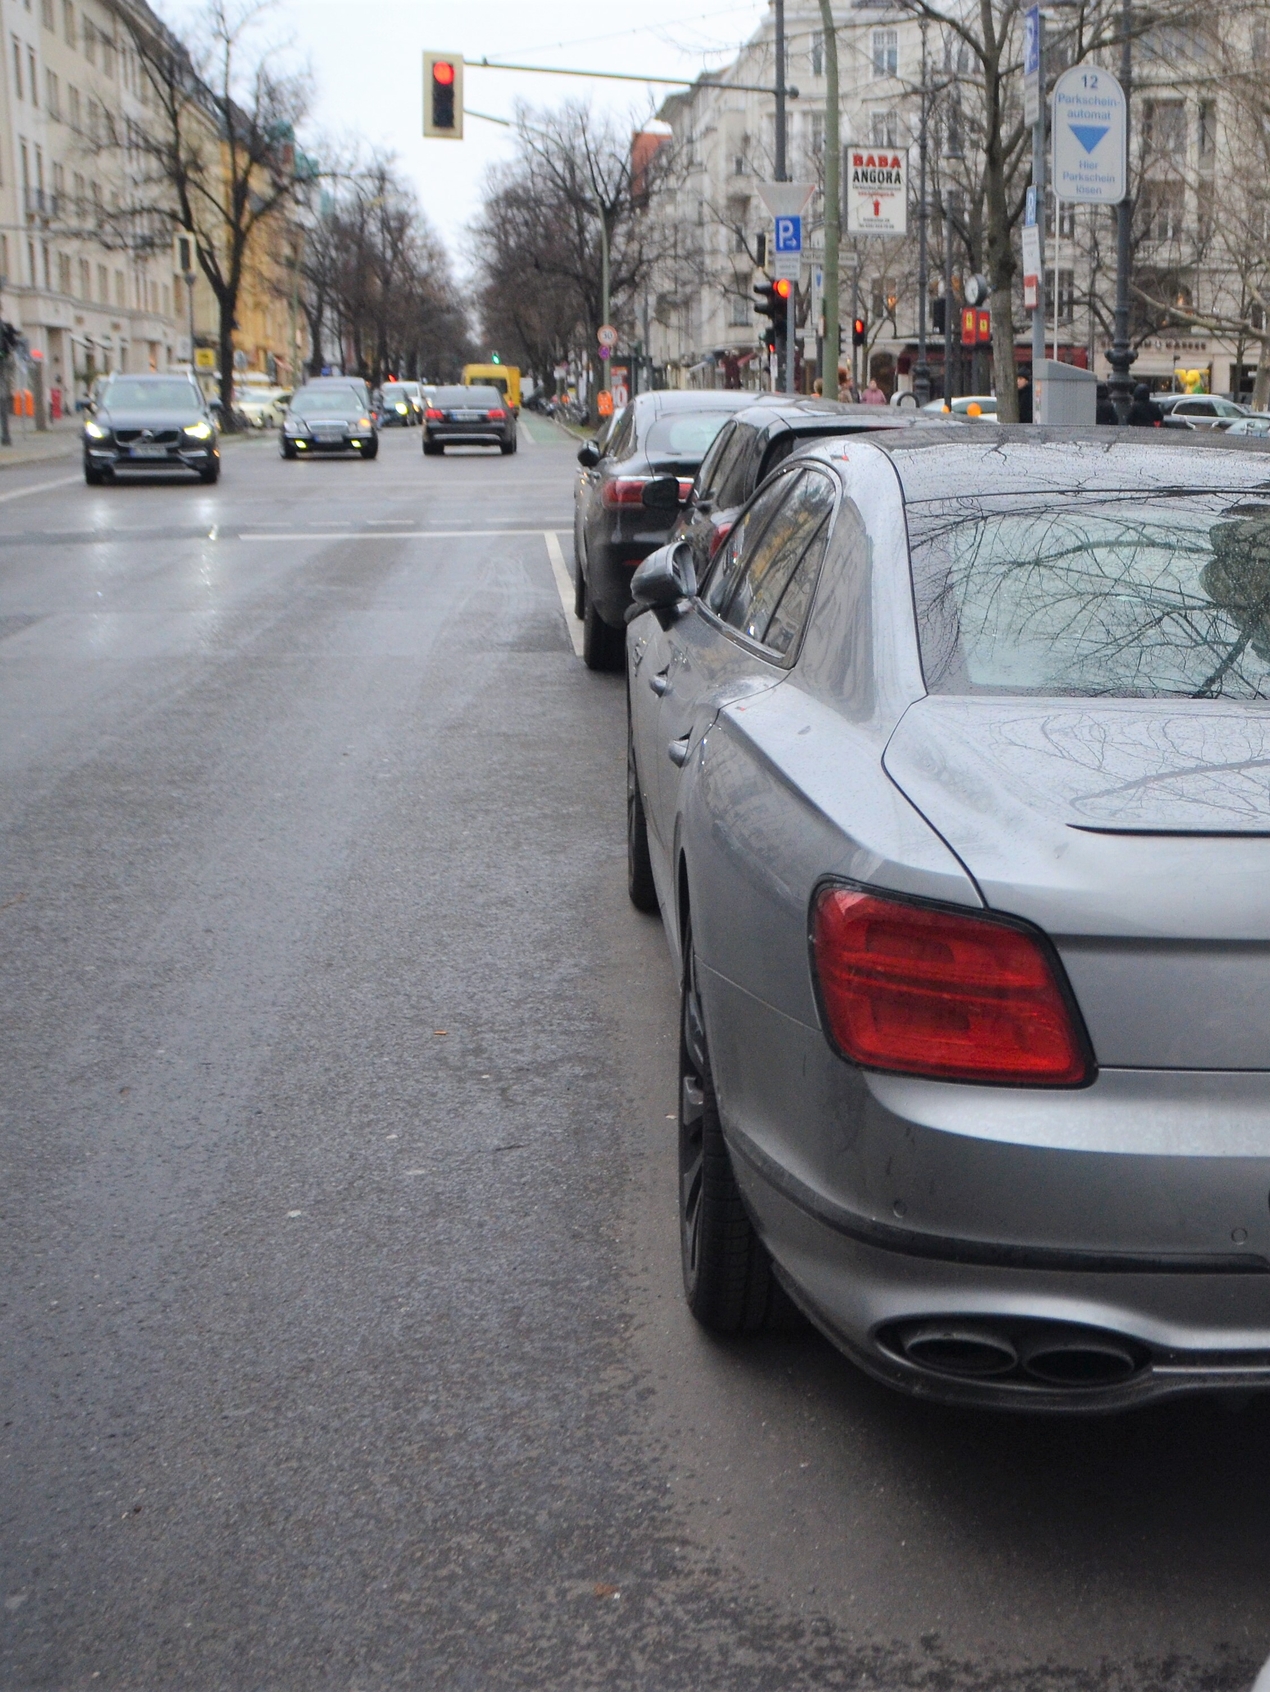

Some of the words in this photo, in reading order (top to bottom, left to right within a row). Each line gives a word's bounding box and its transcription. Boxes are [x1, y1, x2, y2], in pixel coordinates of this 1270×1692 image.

[1082, 74, 1098, 88] 12
[1067, 109, 1111, 119] automat
[853, 153, 901, 168] BABA
[1079, 160, 1098, 169] Hier
[853, 169, 901, 184] ANGORA
[1063, 171, 1115, 183] Parkschein
